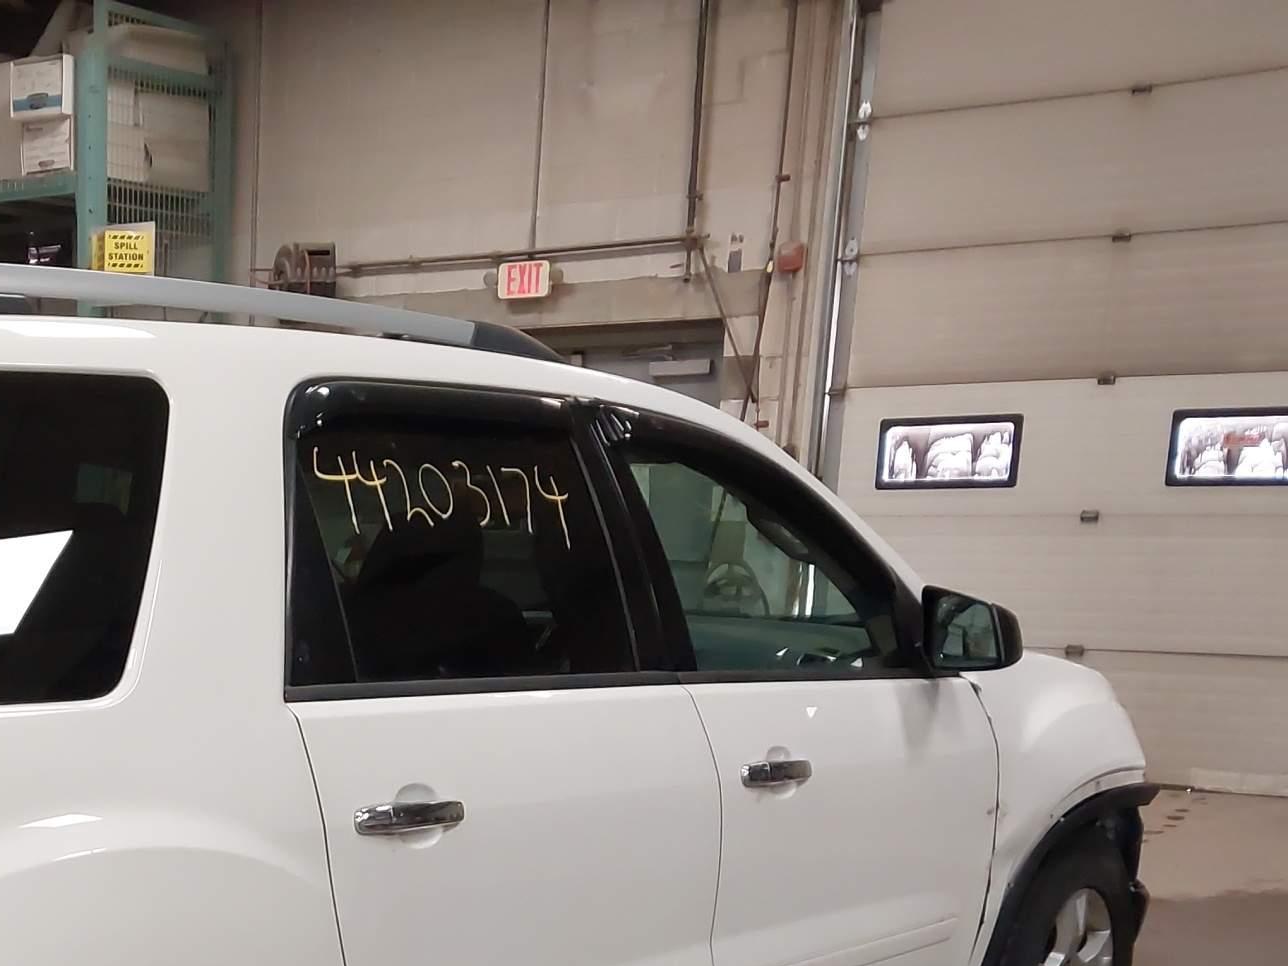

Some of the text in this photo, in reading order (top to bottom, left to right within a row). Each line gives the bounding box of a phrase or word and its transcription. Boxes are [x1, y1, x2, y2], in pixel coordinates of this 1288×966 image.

[114, 242, 138, 250] SPILL
[108, 253, 144, 261] STATION
[506, 263, 543, 295] EXIT
[313, 446, 571, 550] 44203174
